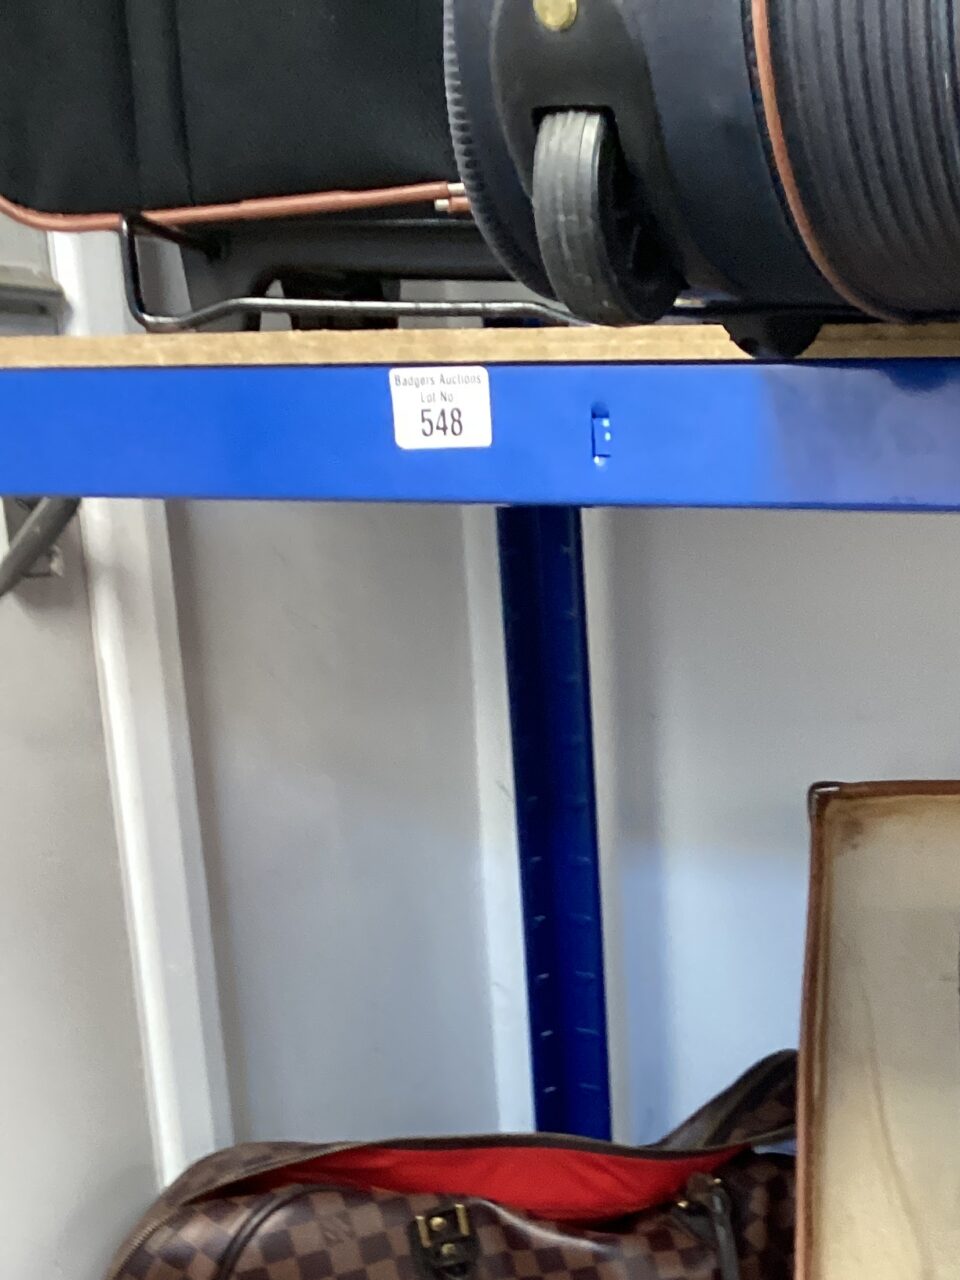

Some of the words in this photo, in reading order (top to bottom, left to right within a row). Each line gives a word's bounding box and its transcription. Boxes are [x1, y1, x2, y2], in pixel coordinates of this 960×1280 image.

[394, 374, 435, 388] Badgers
[440, 373, 481, 385] Auctions
[421, 407, 463, 437] 548
